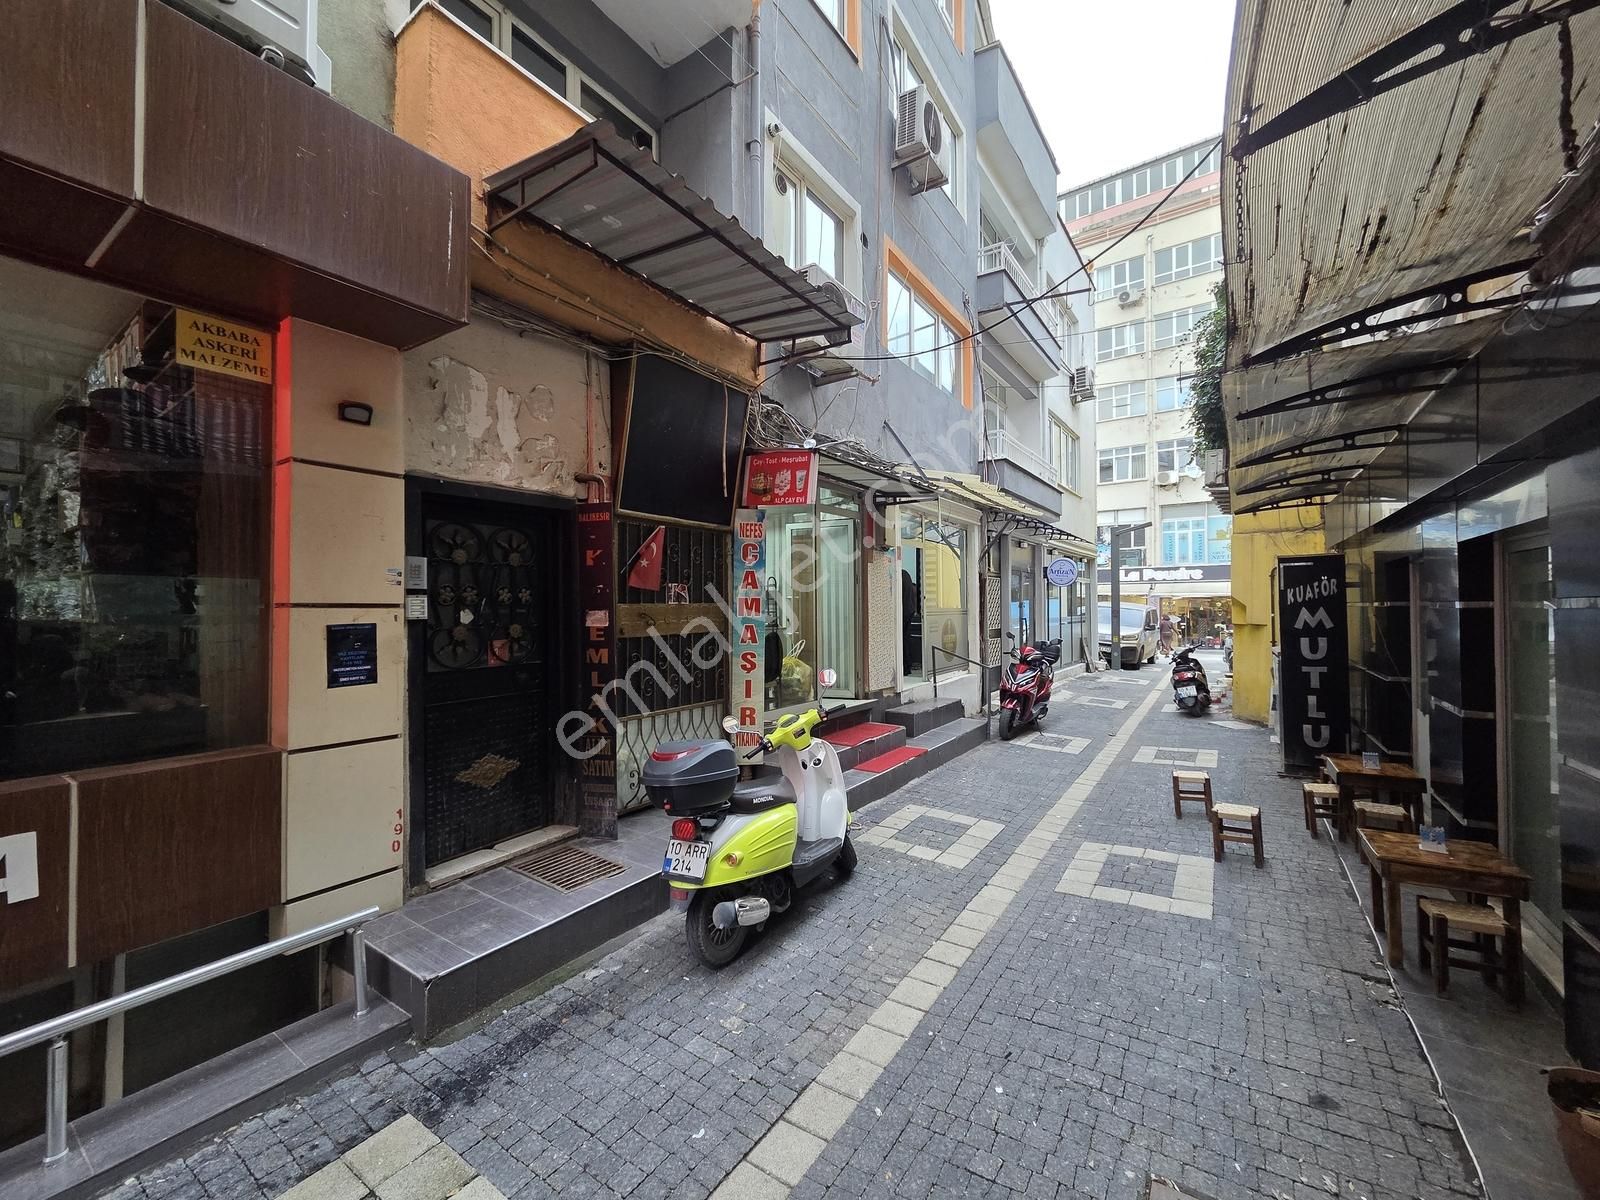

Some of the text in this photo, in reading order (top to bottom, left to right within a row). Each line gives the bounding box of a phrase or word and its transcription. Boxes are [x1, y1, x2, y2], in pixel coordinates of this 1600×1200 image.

[188, 320, 261, 347] AKBABA
[192, 337, 257, 360] ASKERİ
[180, 347, 270, 377] MALZEME
[739, 522, 763, 539] NEFES
[1286, 576, 1338, 605] KUAFÖR
[738, 542, 761, 726] ÇAMAŞIR
[1294, 606, 1335, 748] MUTLU
[583, 759, 614, 777] SATIM
[753, 795, 774, 804] MONDIAL
[670, 842, 707, 859] 10 ARR
[672, 858, 692, 873] 214
